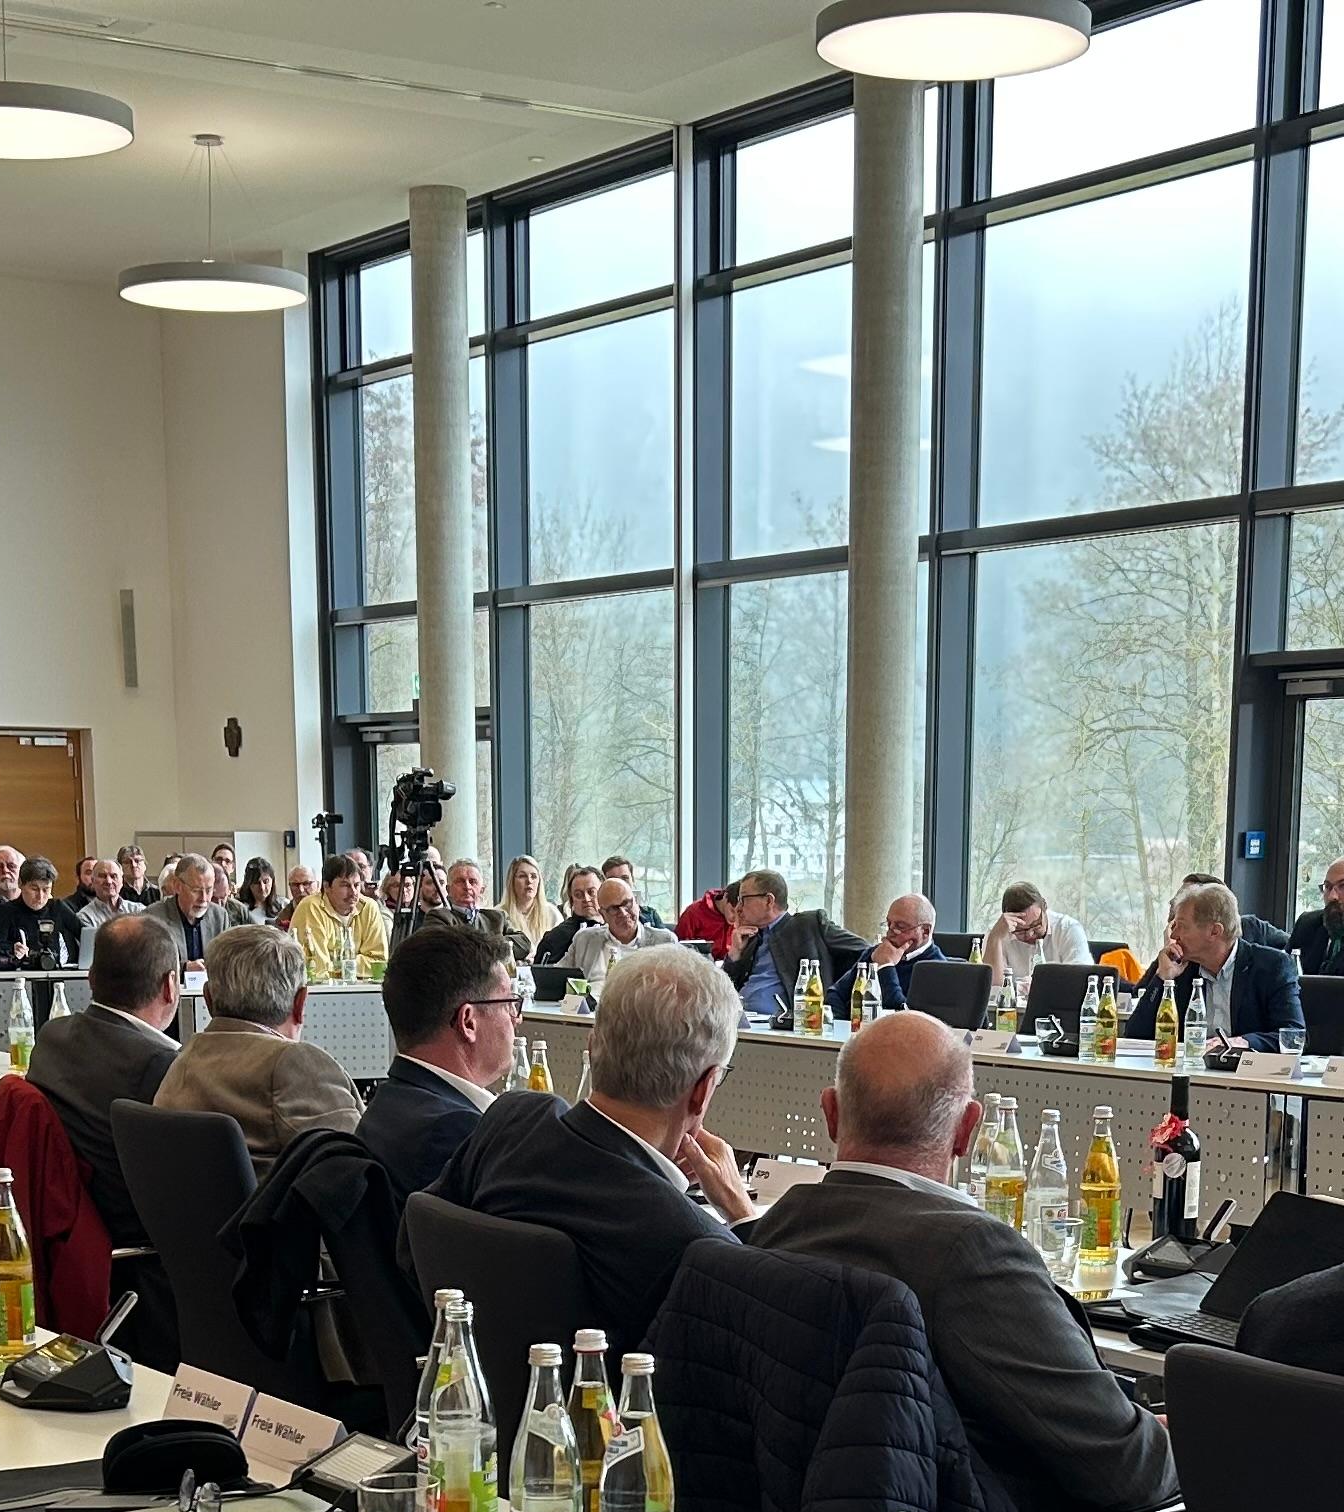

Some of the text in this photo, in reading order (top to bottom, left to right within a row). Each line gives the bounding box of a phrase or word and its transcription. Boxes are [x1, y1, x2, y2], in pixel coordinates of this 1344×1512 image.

[172, 1383, 222, 1411] Freie Wähler
[251, 1414, 306, 1445] Freie Wähler
